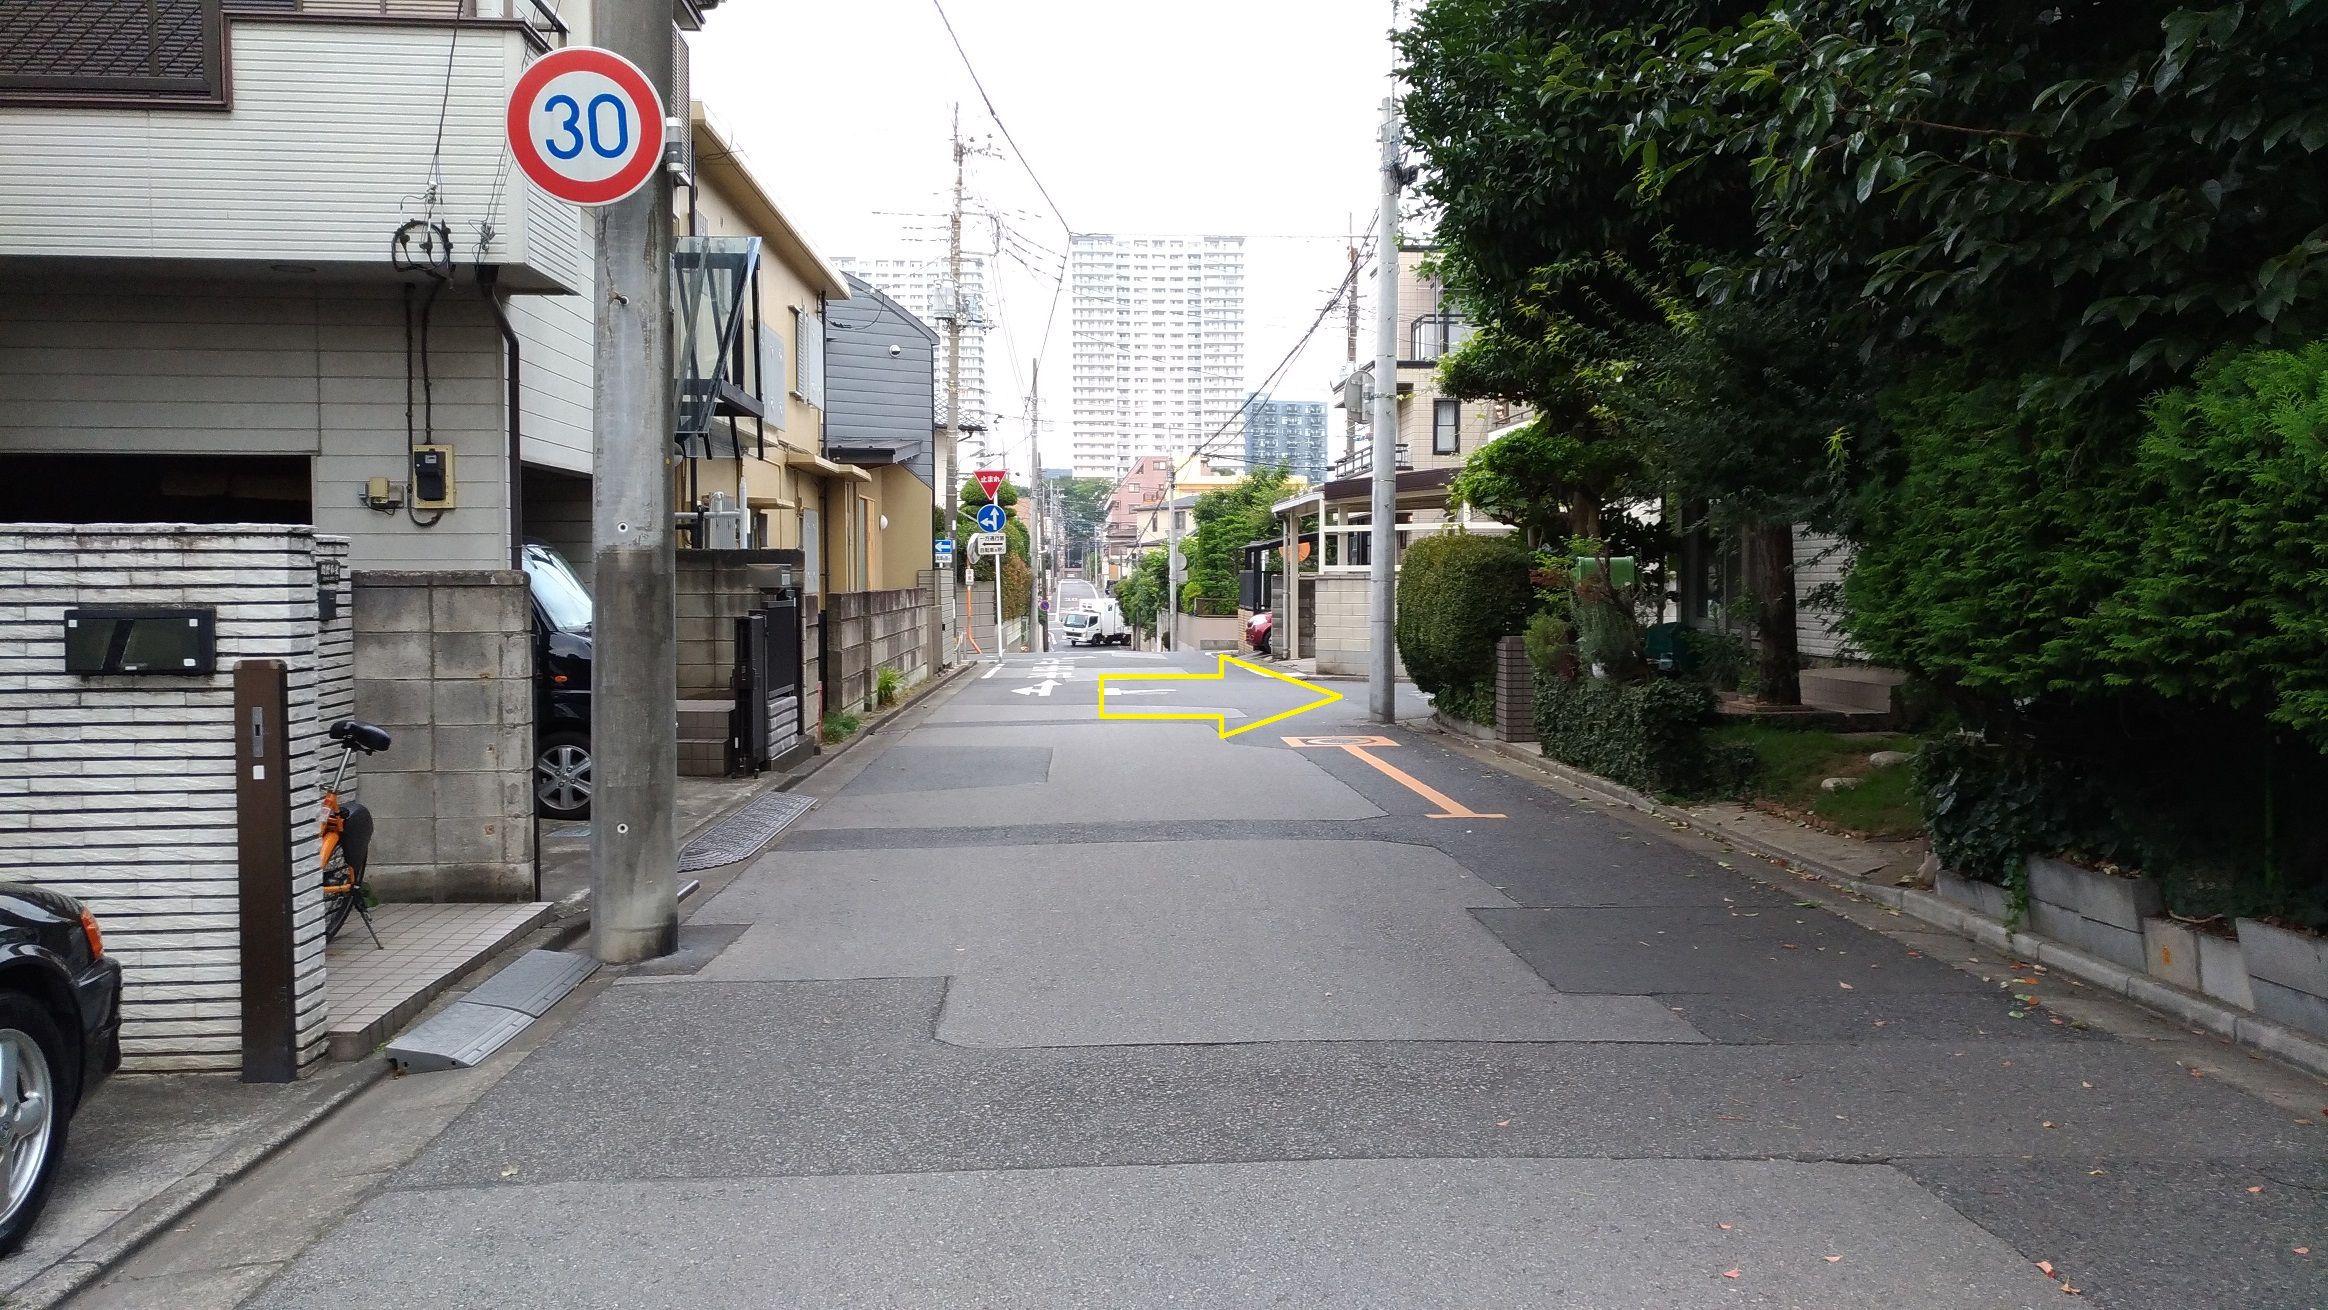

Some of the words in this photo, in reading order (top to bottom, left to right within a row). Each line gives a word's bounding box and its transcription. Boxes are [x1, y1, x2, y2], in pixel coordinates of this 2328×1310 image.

[544, 93, 629, 160] 30
[980, 475, 1001, 483] 止まれ
